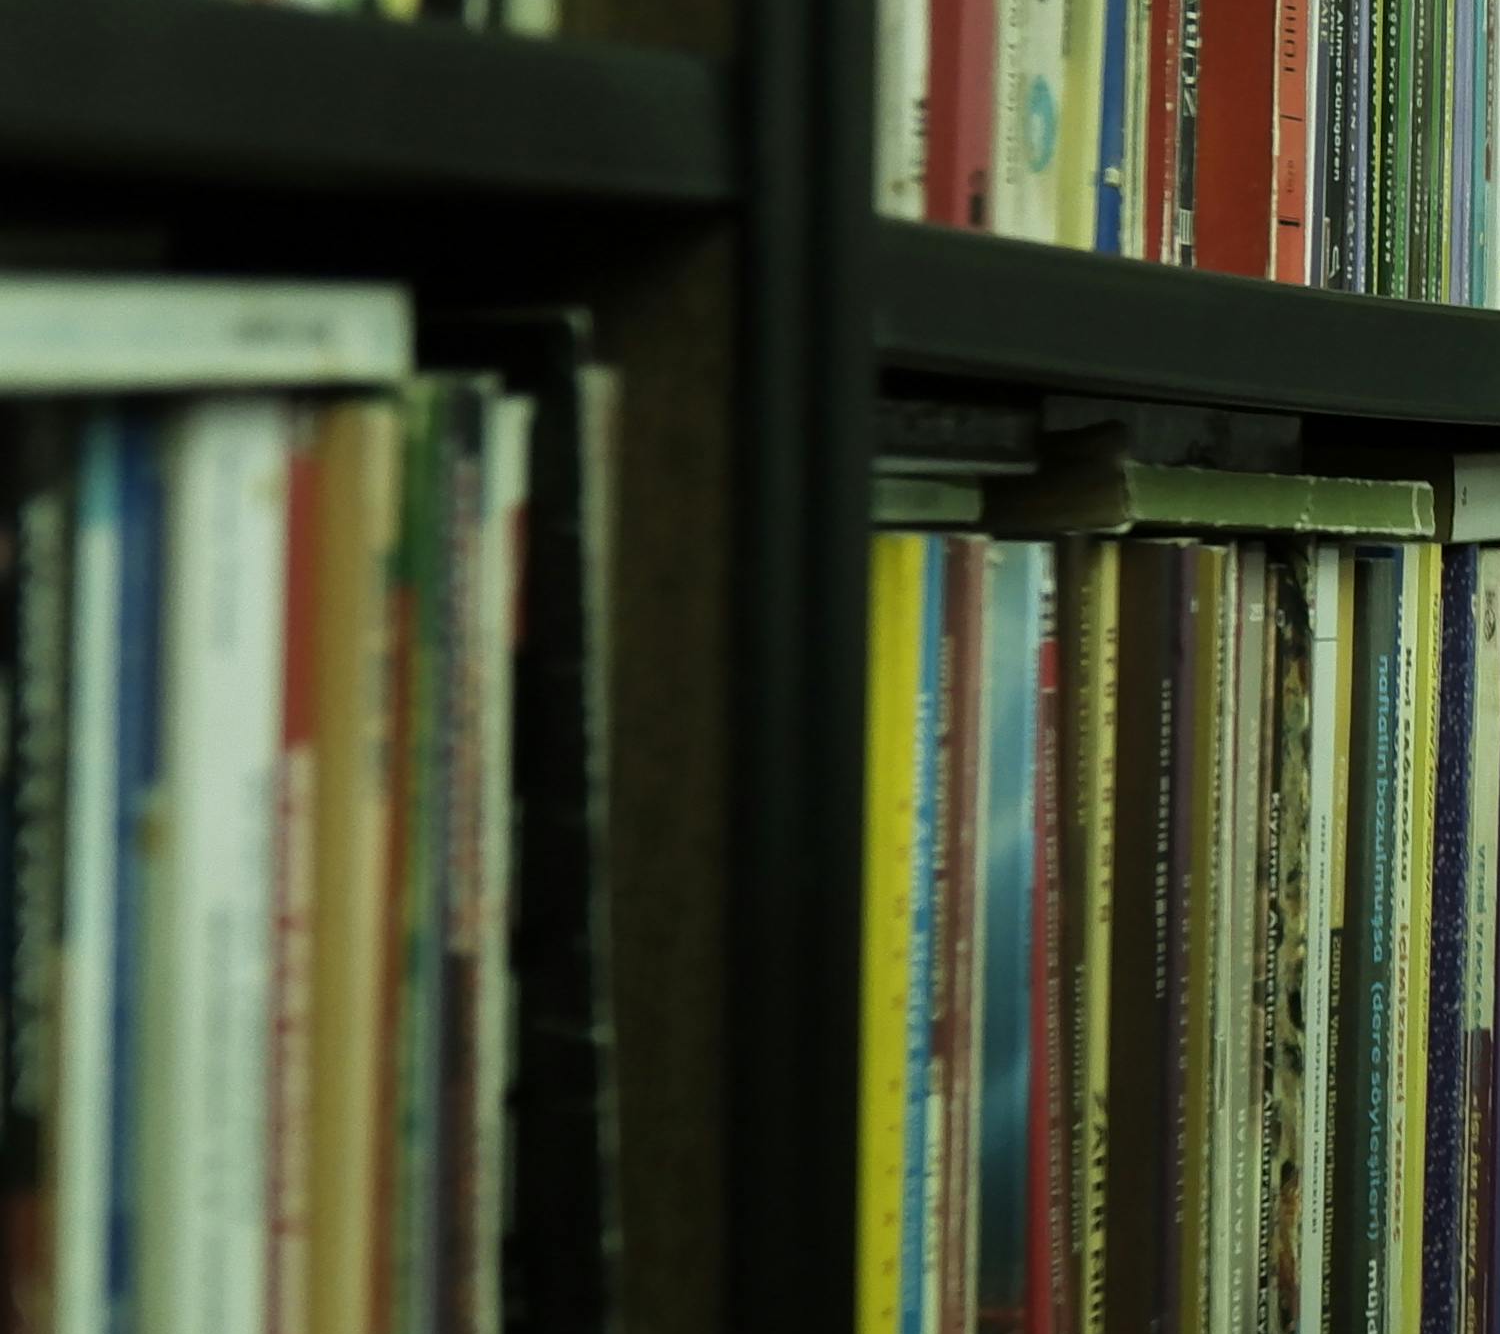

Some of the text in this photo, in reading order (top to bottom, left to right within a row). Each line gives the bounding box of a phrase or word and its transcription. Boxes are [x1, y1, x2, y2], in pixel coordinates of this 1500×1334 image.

[1335, 9, 1345, 78] Ahmet
[1332, 80, 1344, 181] Güngören
[1376, 654, 1391, 772] naftalin
[1403, 646, 1413, 706] Nuri
[1268, 791, 1281, 898] Kıyamet
[1371, 777, 1390, 964] bozulmuşsa
[1264, 909, 1279, 1048] Alametleri
[1370, 981, 1385, 1065] (dere
[1258, 1091, 1272, 1279] Abdurrahman
[1366, 1070, 1383, 1241] söyleşileri)
